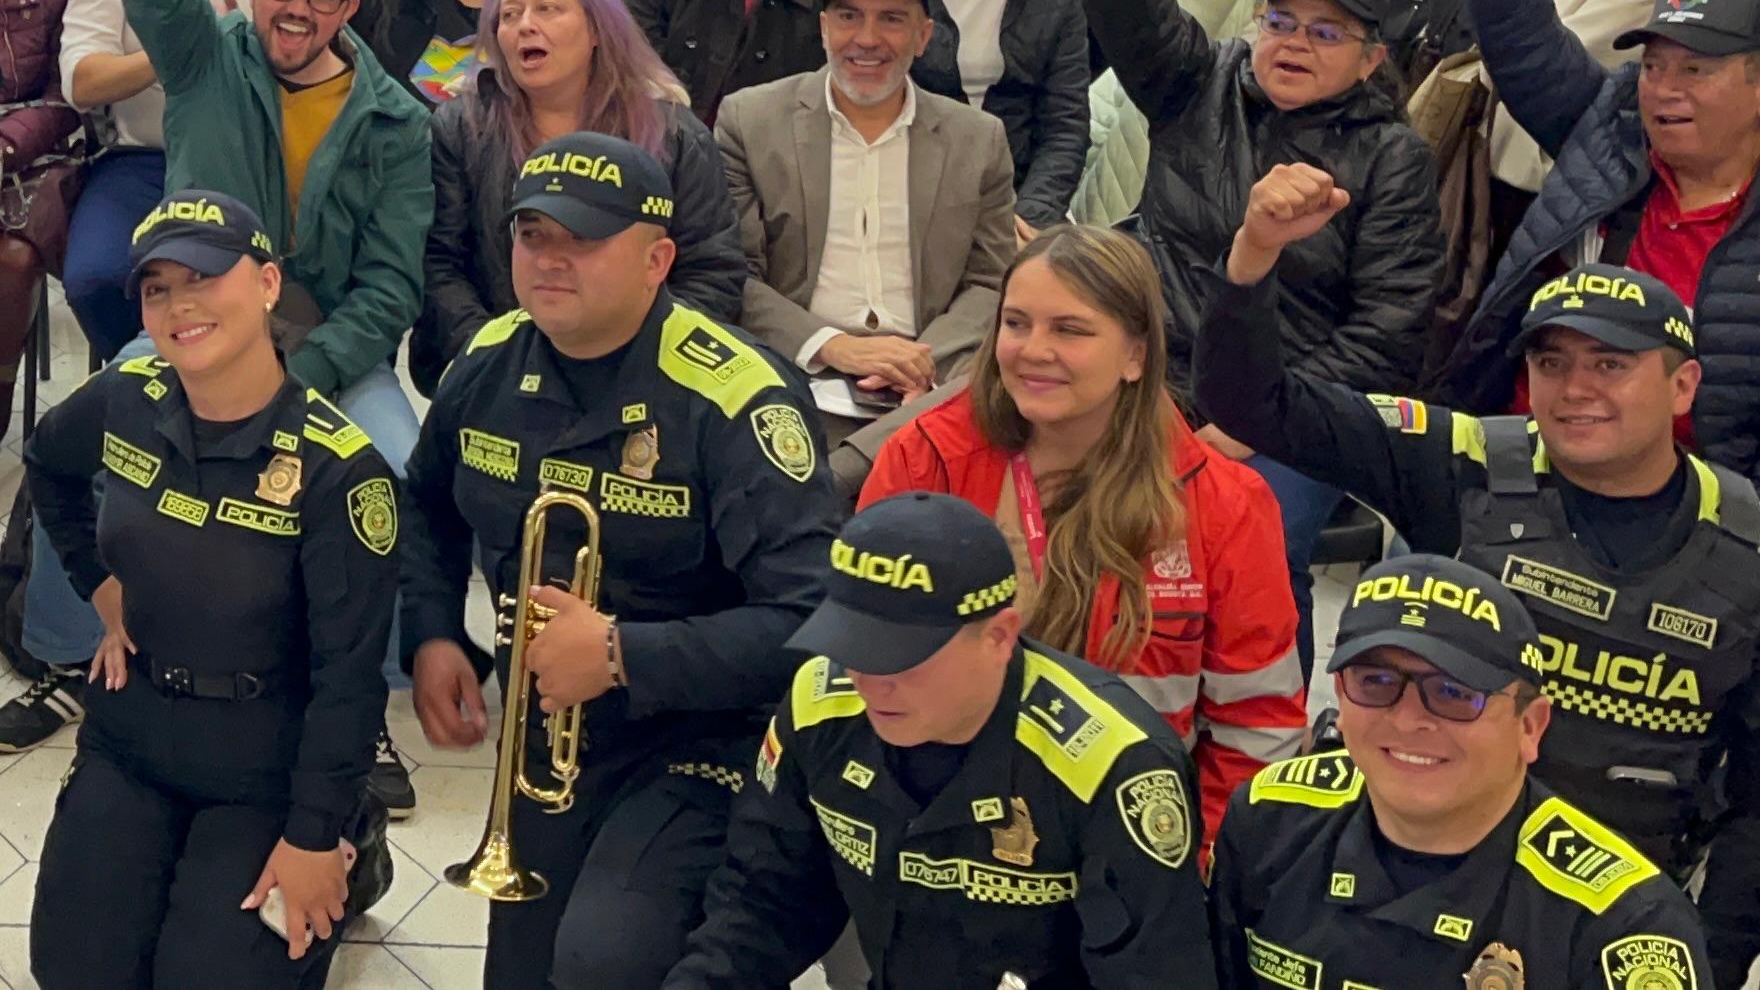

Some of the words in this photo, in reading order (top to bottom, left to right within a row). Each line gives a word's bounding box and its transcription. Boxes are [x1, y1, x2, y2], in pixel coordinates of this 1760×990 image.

[520, 152, 622, 188] POLICÍA
[132, 198, 225, 245] POLICÍA
[1530, 273, 1646, 312] POLICÍA
[831, 539, 933, 592] OLICÍA
[1352, 574, 1501, 632] POLICÍA
[1512, 573, 1547, 595] MIGUEL
[1551, 587, 1600, 612] BARRERA
[1538, 634, 1701, 706] OLICÍA
[835, 831, 870, 854] ORTIZ
[973, 870, 1064, 892] POLICÍA
[1612, 953, 1687, 981] NACIONAL
[1616, 940, 1678, 961] POLICÍA
